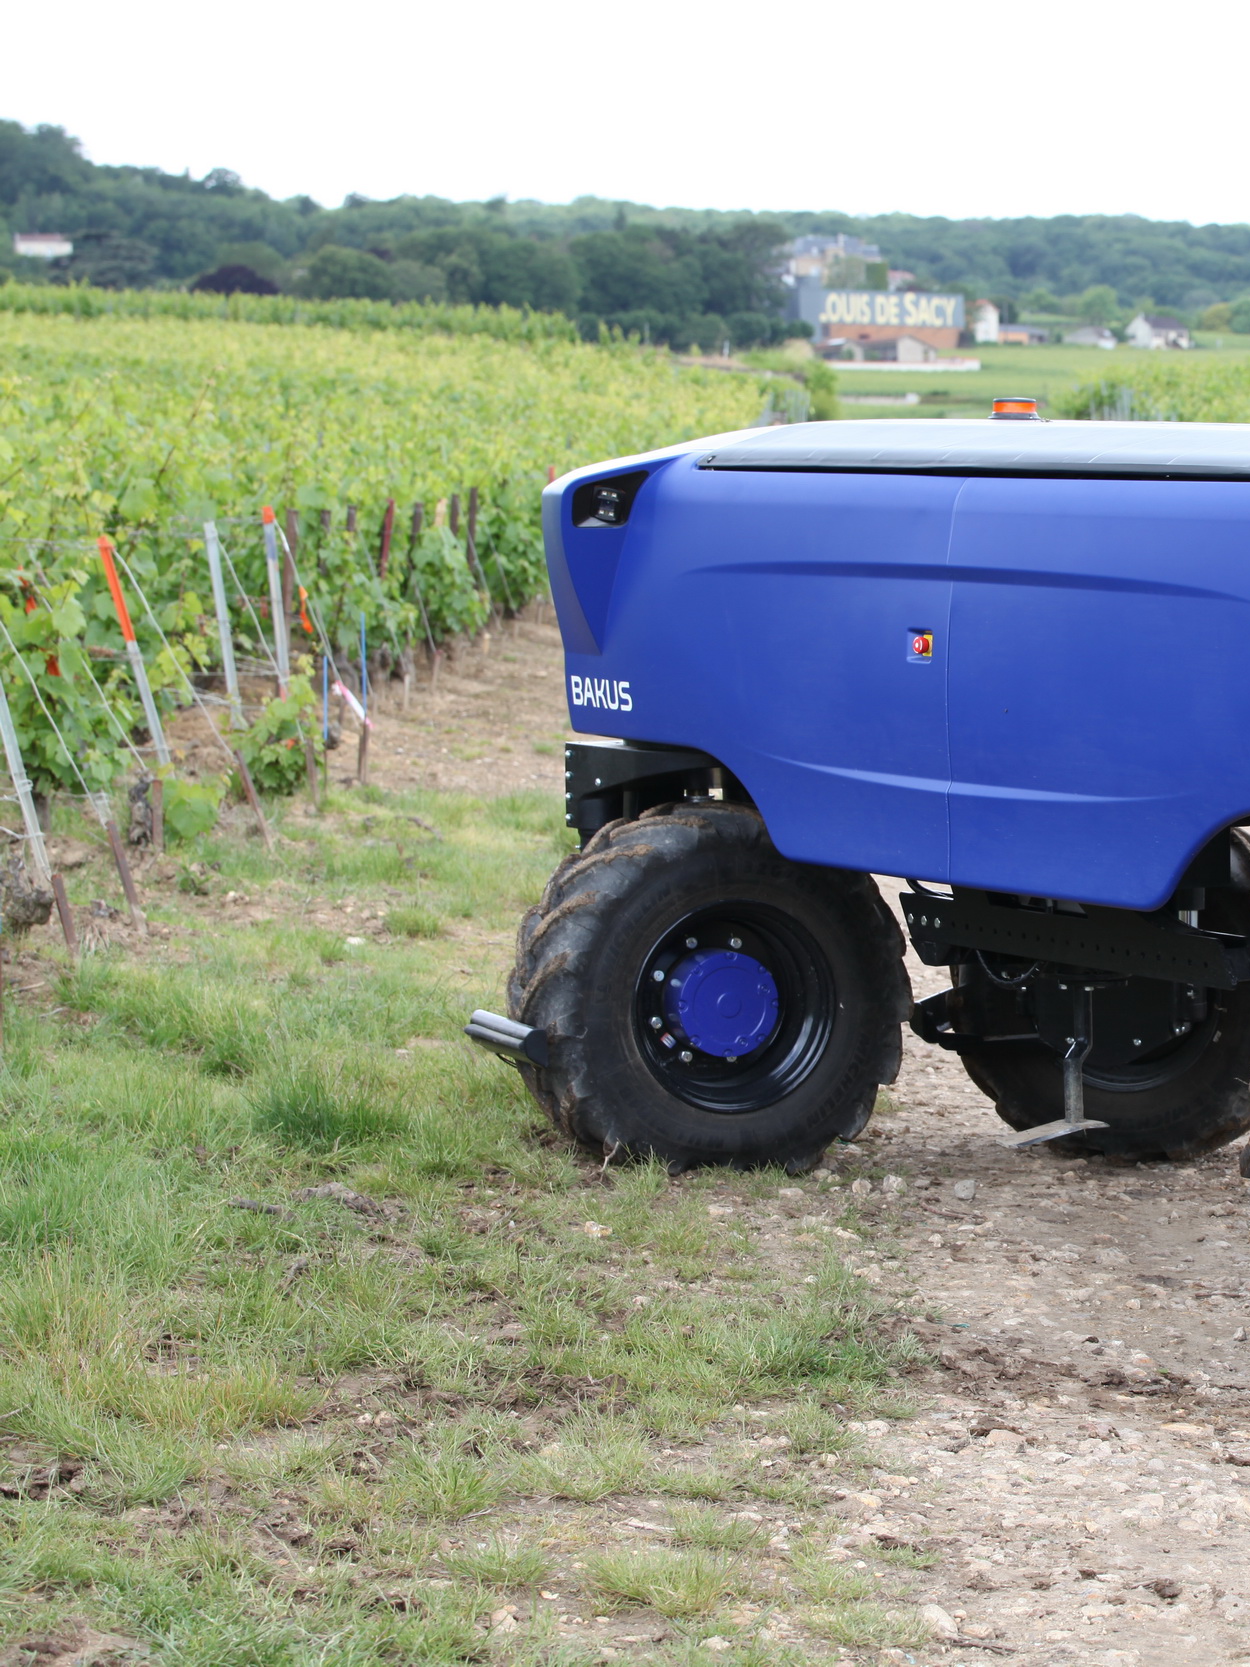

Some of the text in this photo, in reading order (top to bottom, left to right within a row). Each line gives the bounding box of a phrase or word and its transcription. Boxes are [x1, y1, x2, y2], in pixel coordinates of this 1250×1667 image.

[819, 292, 956, 326] OUIS DE SACY
[571, 675, 633, 712] BAKUS
